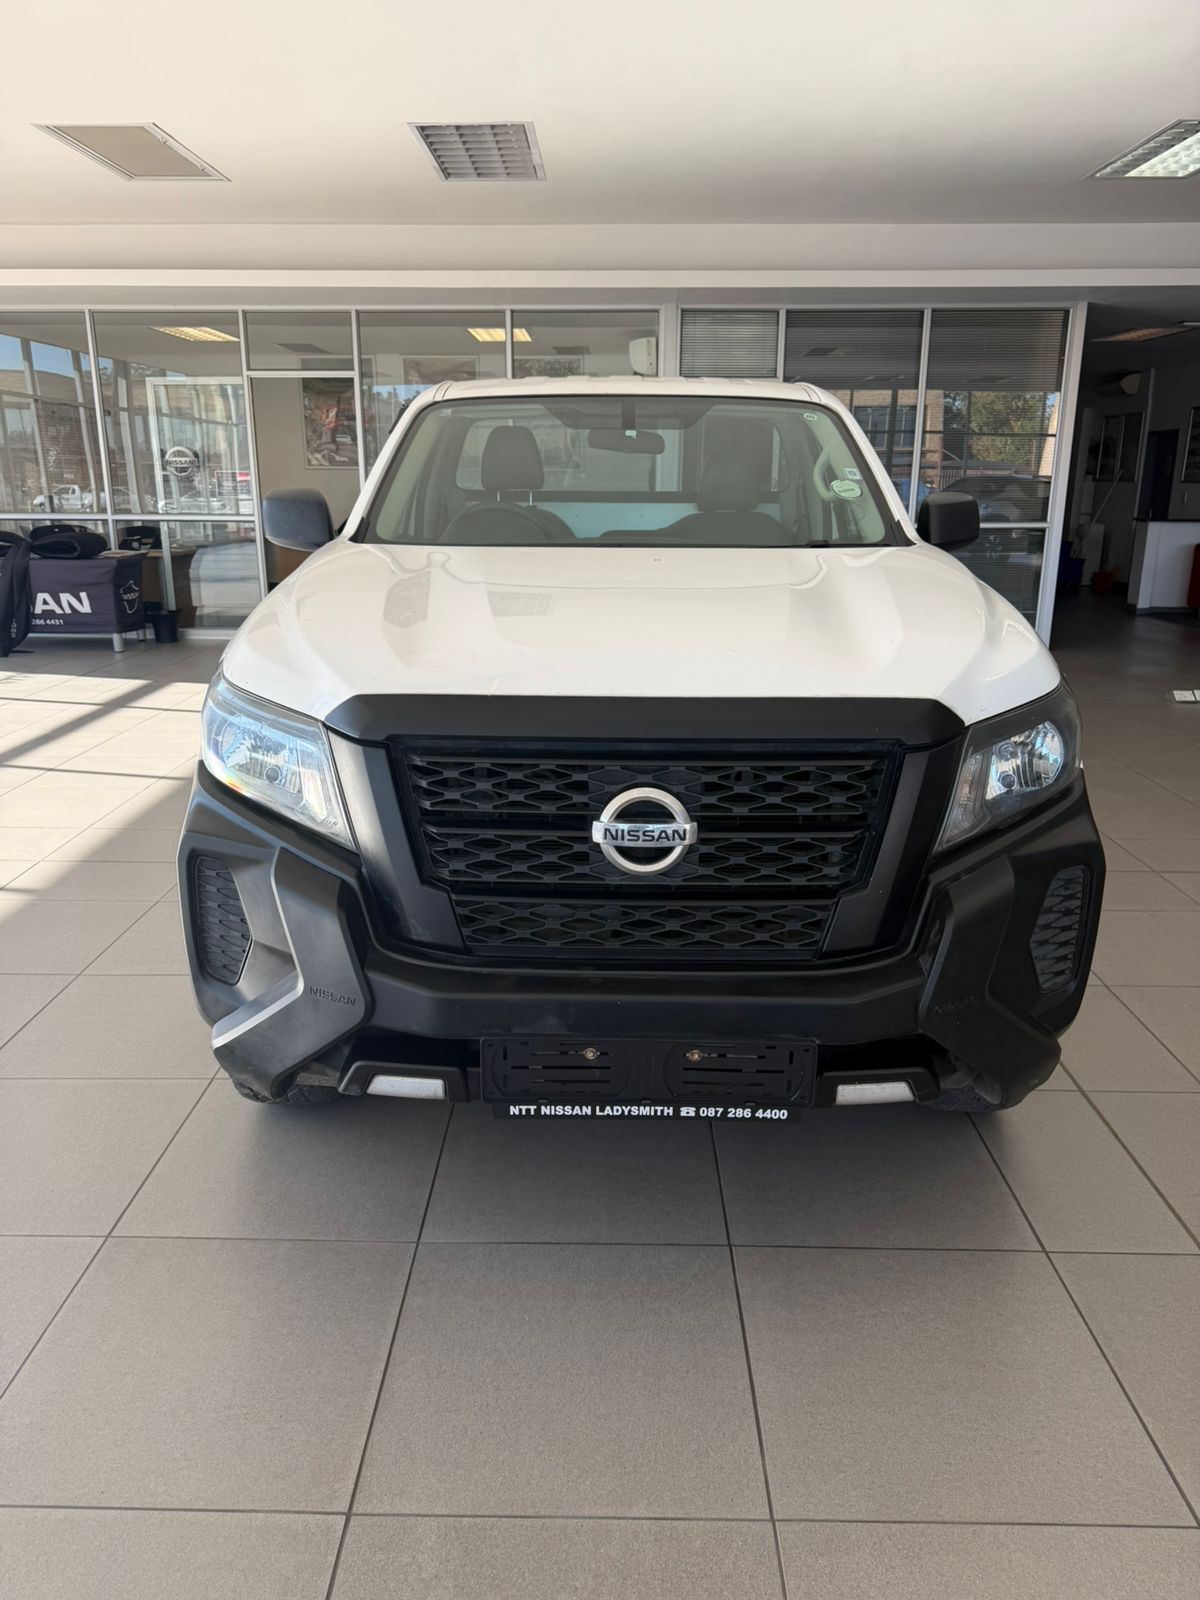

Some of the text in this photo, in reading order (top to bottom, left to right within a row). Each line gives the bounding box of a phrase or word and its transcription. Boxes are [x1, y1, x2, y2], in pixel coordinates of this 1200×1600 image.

[31, 592, 92, 614] AN
[603, 828, 687, 842] NISSAN
[310, 986, 356, 1006] NISSAN
[509, 1105, 788, 1120] NTT NISSAN LADYSMITH 087 286 4400
